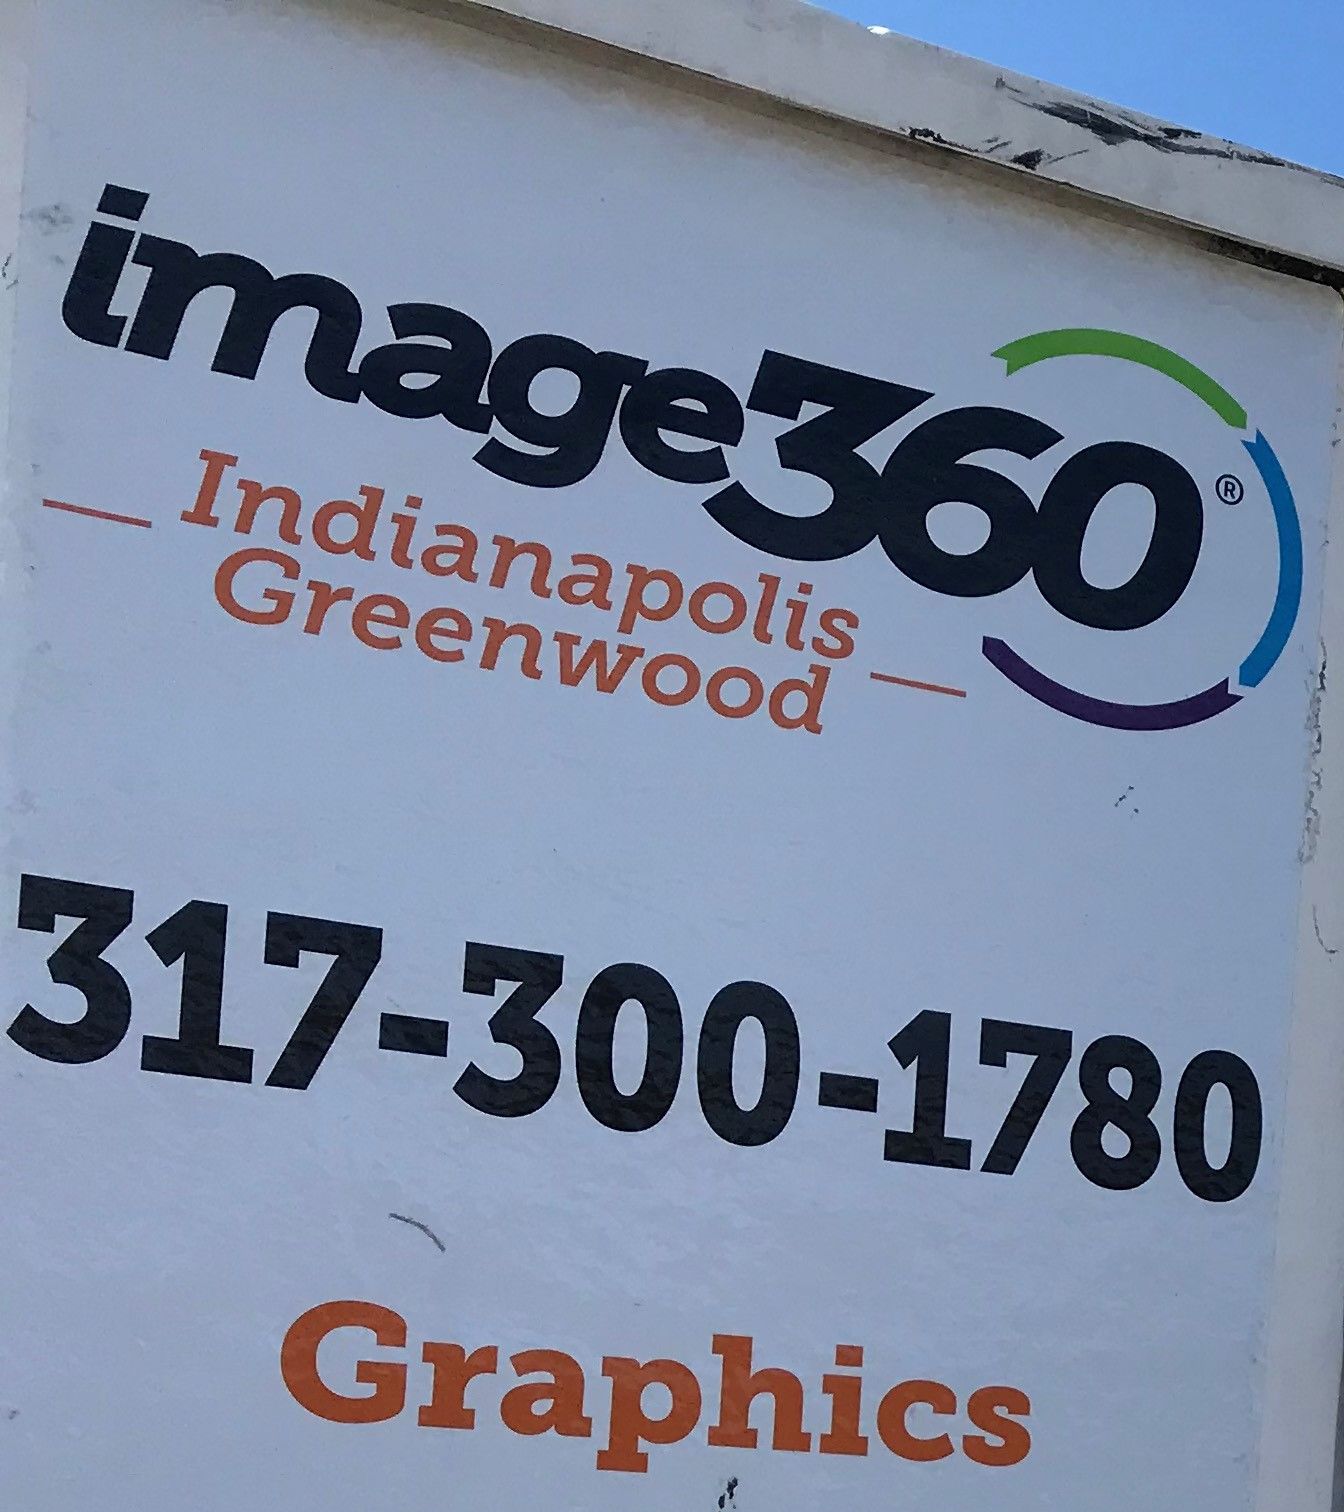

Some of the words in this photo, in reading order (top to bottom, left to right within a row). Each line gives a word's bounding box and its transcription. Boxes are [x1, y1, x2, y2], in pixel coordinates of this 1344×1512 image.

[180, 449, 860, 660] Indianapolis
[213, 547, 831, 735] Greenwood
[6, 874, 1262, 1202] 317-300-1780
[280, 1300, 1032, 1473] Graphics
